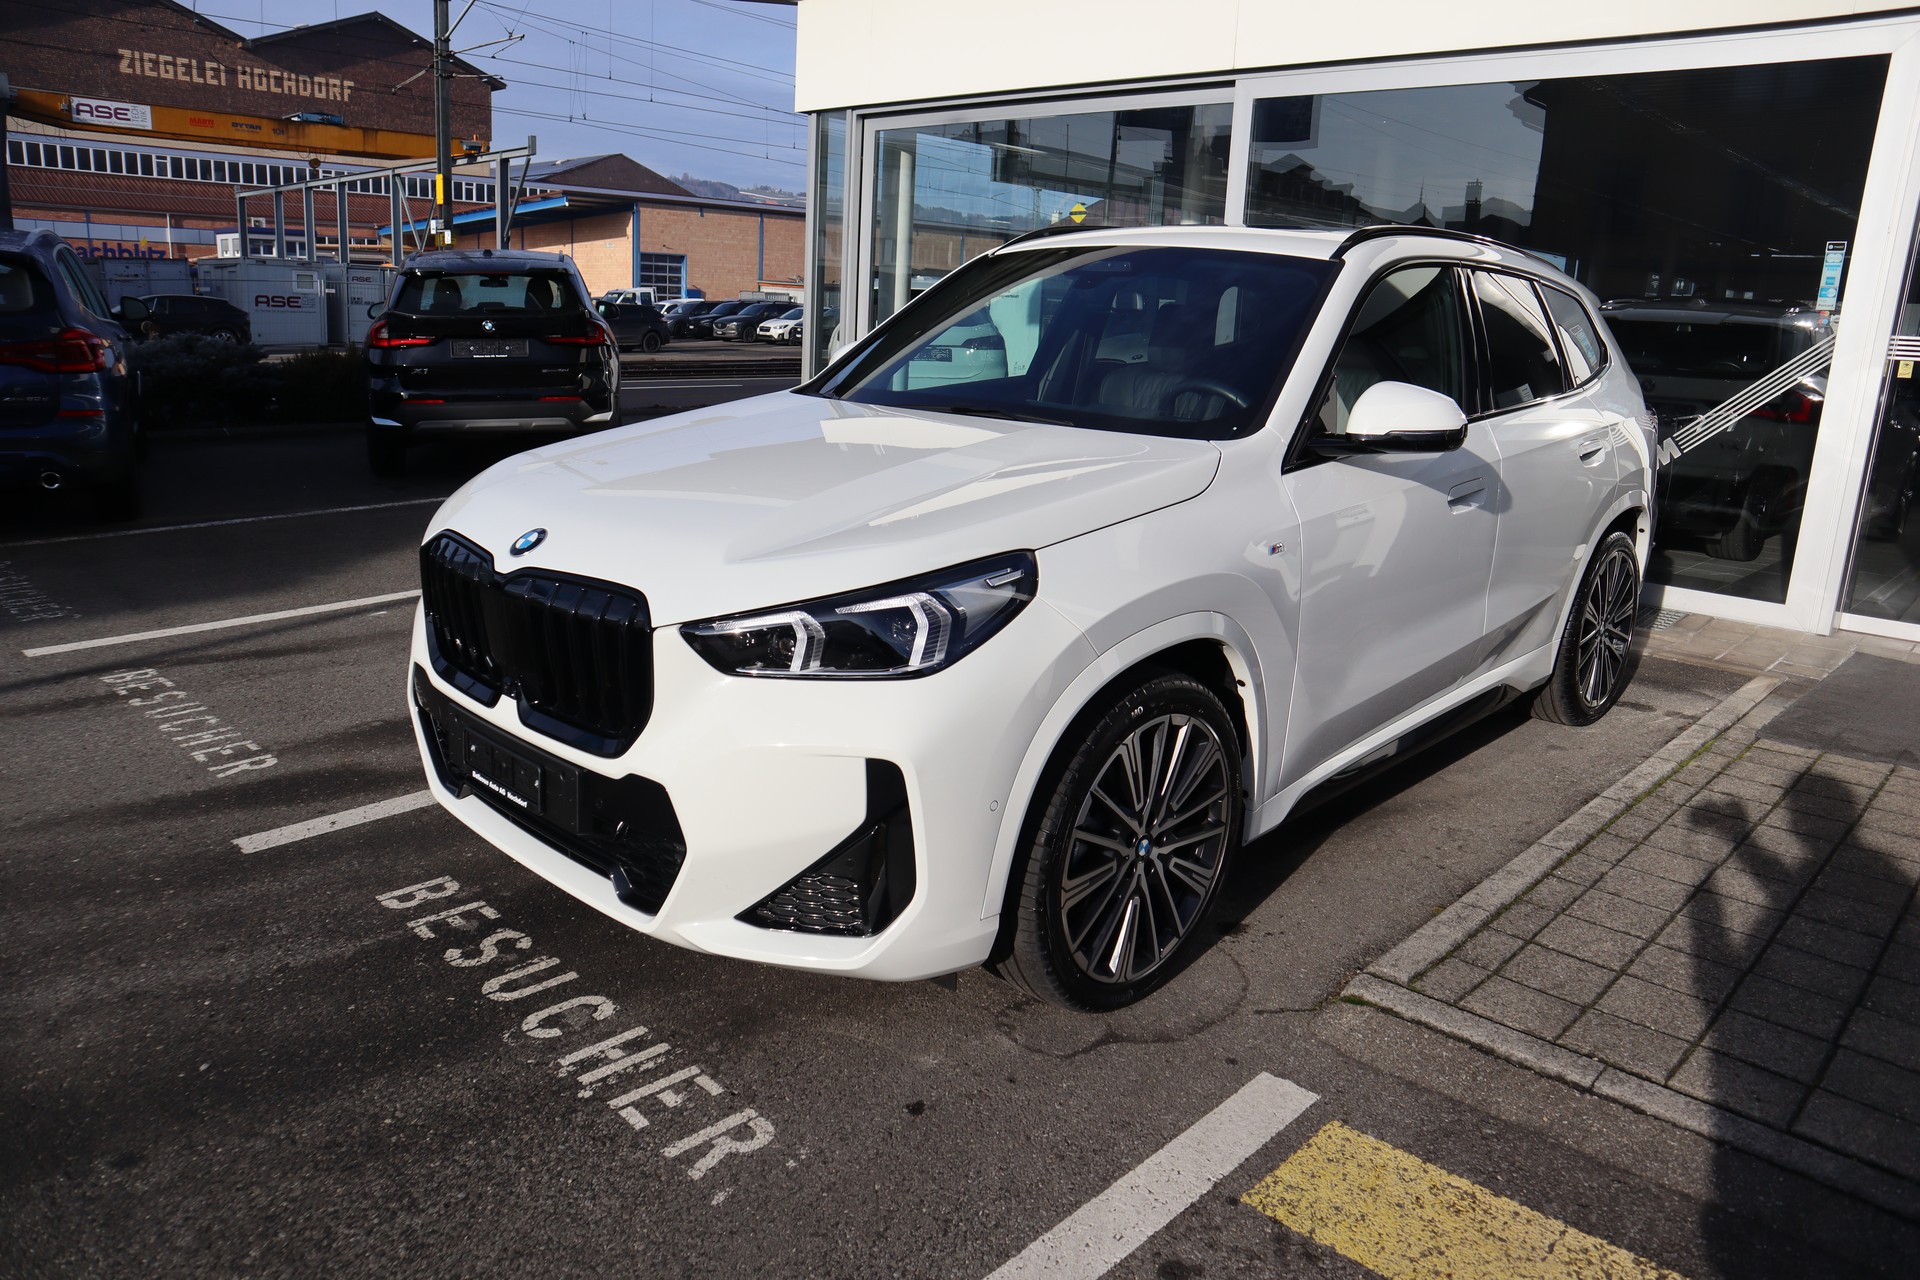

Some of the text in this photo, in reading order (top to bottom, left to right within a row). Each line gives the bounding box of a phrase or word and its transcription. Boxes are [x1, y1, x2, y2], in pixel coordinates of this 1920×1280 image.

[117, 49, 354, 102] ZIEGELEI HOCHDORF
[76, 103, 131, 121] ASE
[74, 240, 166, 258] achblitz
[255, 295, 301, 308] ASE
[99, 668, 279, 779] BESUCHER
[375, 875, 776, 1181] BESUCHER
